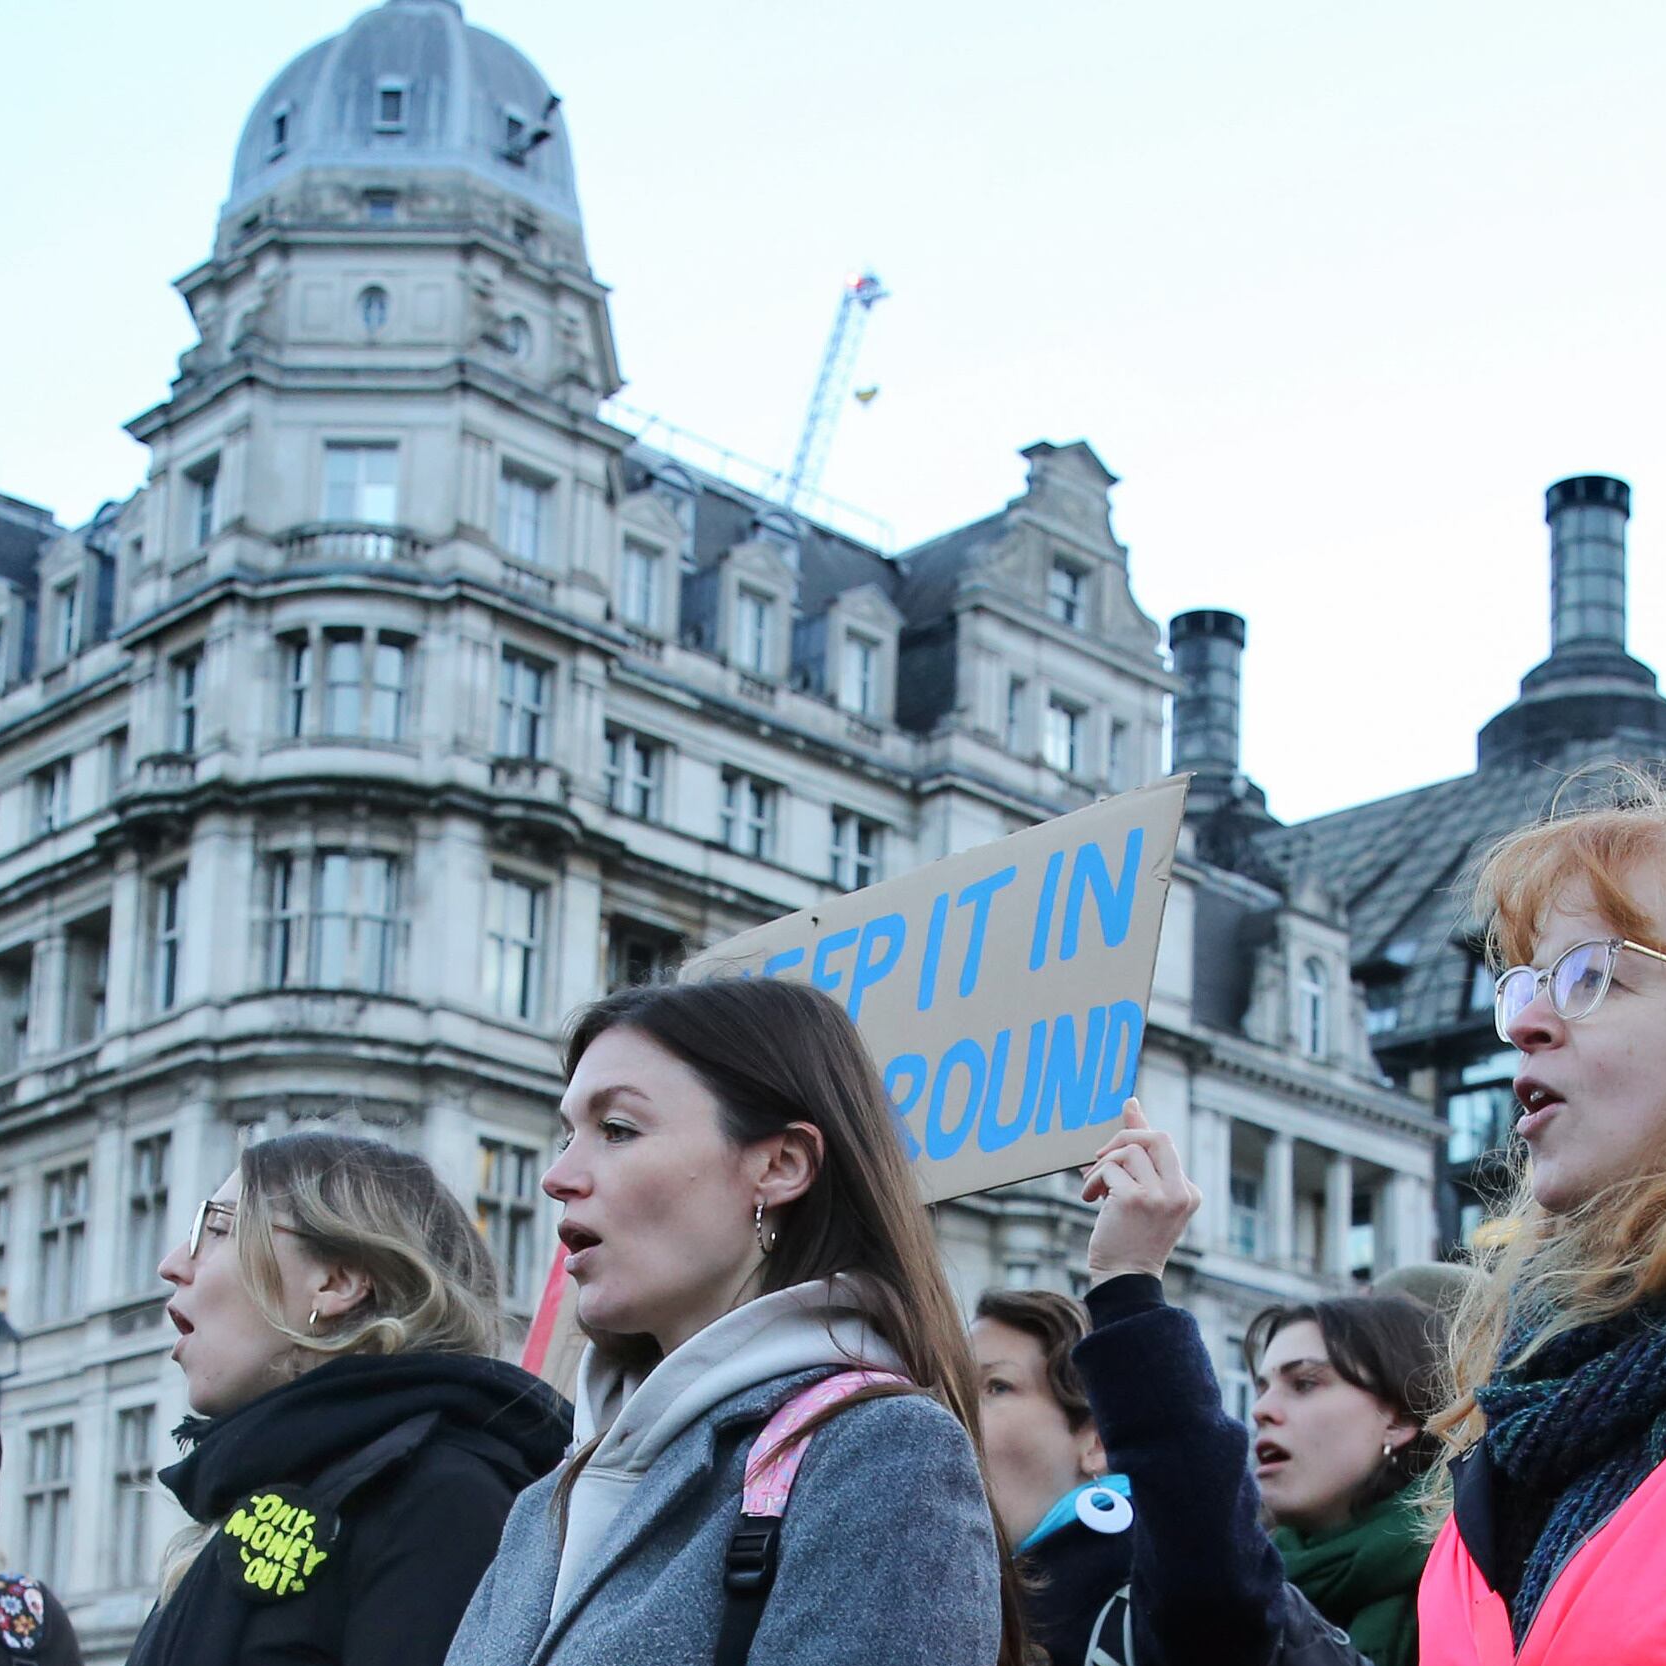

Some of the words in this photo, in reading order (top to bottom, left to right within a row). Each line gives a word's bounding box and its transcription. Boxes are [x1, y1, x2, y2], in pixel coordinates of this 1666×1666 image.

[917, 865, 1016, 1011] IT
[1029, 827, 1143, 971] IN
[883, 1000, 1143, 1162] ROUND
[224, 1508, 328, 1576] MONEY
[252, 1494, 316, 1536] OILY
[244, 1556, 296, 1596] OUT
